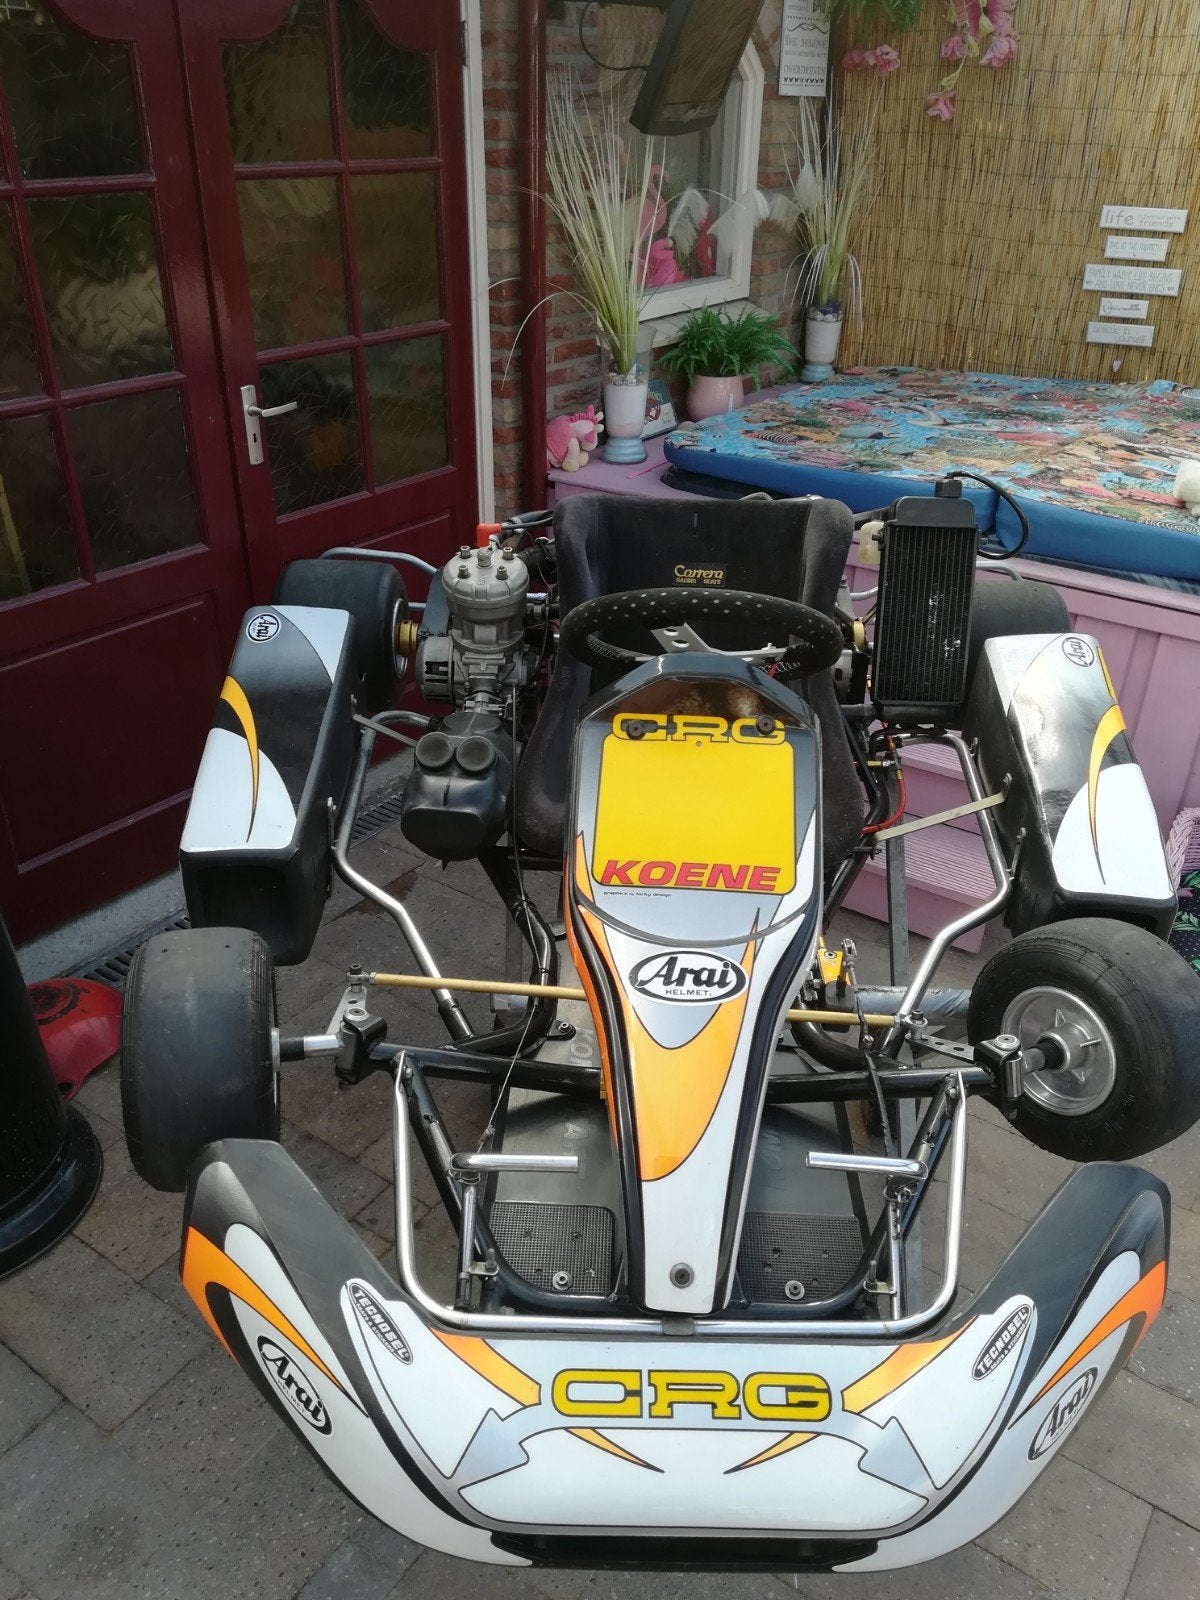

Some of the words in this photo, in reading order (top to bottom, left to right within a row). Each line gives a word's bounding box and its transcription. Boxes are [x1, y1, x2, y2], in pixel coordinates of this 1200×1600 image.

[1104, 209, 1134, 226] life
[1138, 218, 1174, 228] friends
[1088, 268, 1111, 279] FAMILY
[1149, 272, 1173, 283] BEGINS
[1095, 279, 1108, 289] AND
[1126, 281, 1146, 292] NEVER
[674, 564, 724, 579] Carrera
[256, 615, 277, 638] Arai
[1065, 640, 1089, 666] Arai
[612, 712, 786, 745] CRG
[600, 859, 782, 892] KOENE
[636, 955, 733, 989] Arai
[354, 1289, 408, 1358] TECNOSEL
[976, 1311, 1028, 1374] TECNOSEL
[261, 1352, 323, 1422] Arai
[551, 1368, 832, 1422] CRG
[1033, 1371, 1090, 1456] Arai
